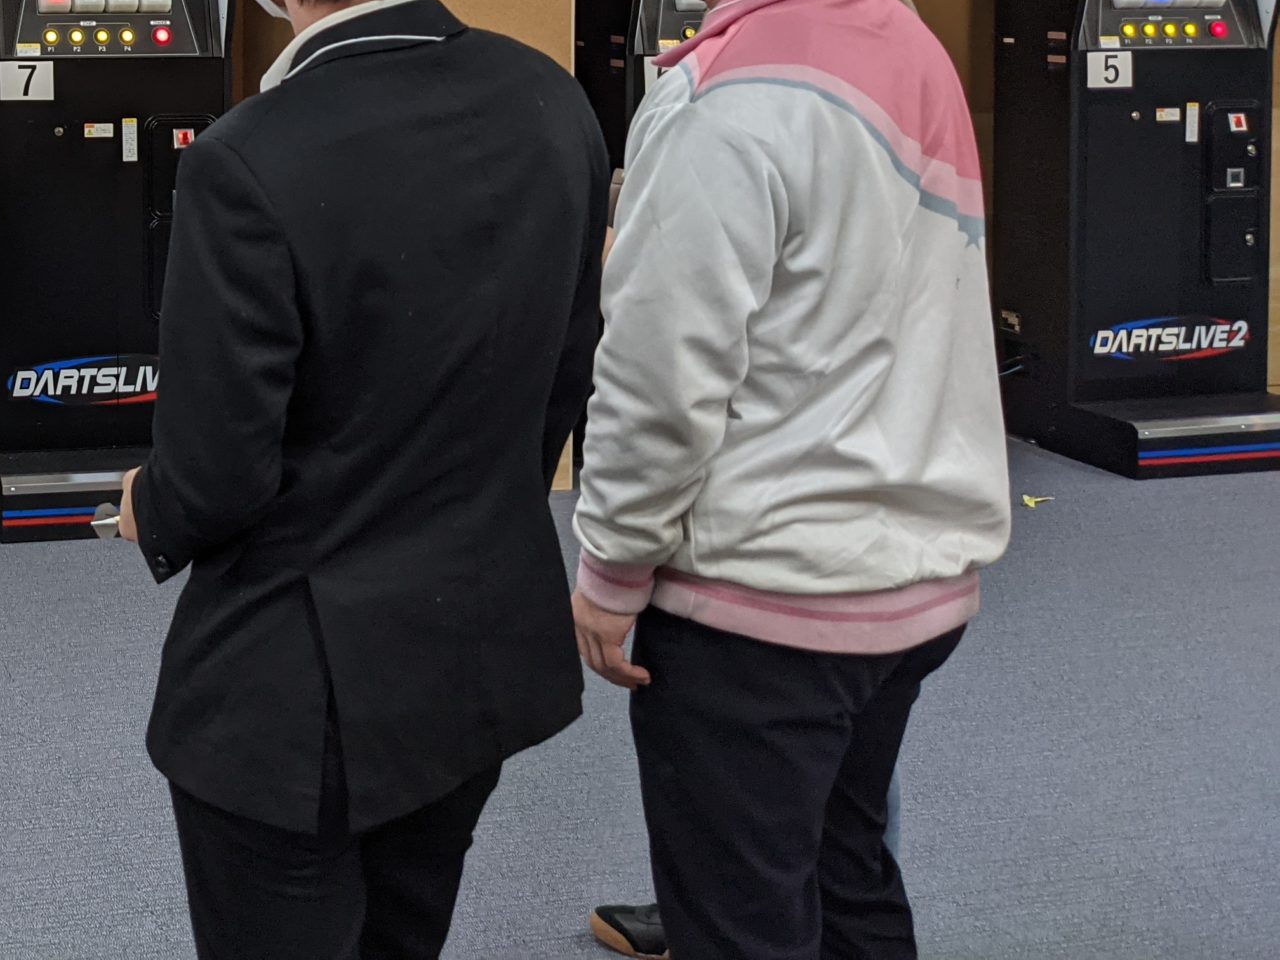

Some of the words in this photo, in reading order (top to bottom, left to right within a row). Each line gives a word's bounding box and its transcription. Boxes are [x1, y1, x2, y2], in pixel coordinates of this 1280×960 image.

[17, 64, 37, 97] 7
[1103, 54, 1120, 84] 5
[1093, 320, 1249, 354] DARTSLIVE2
